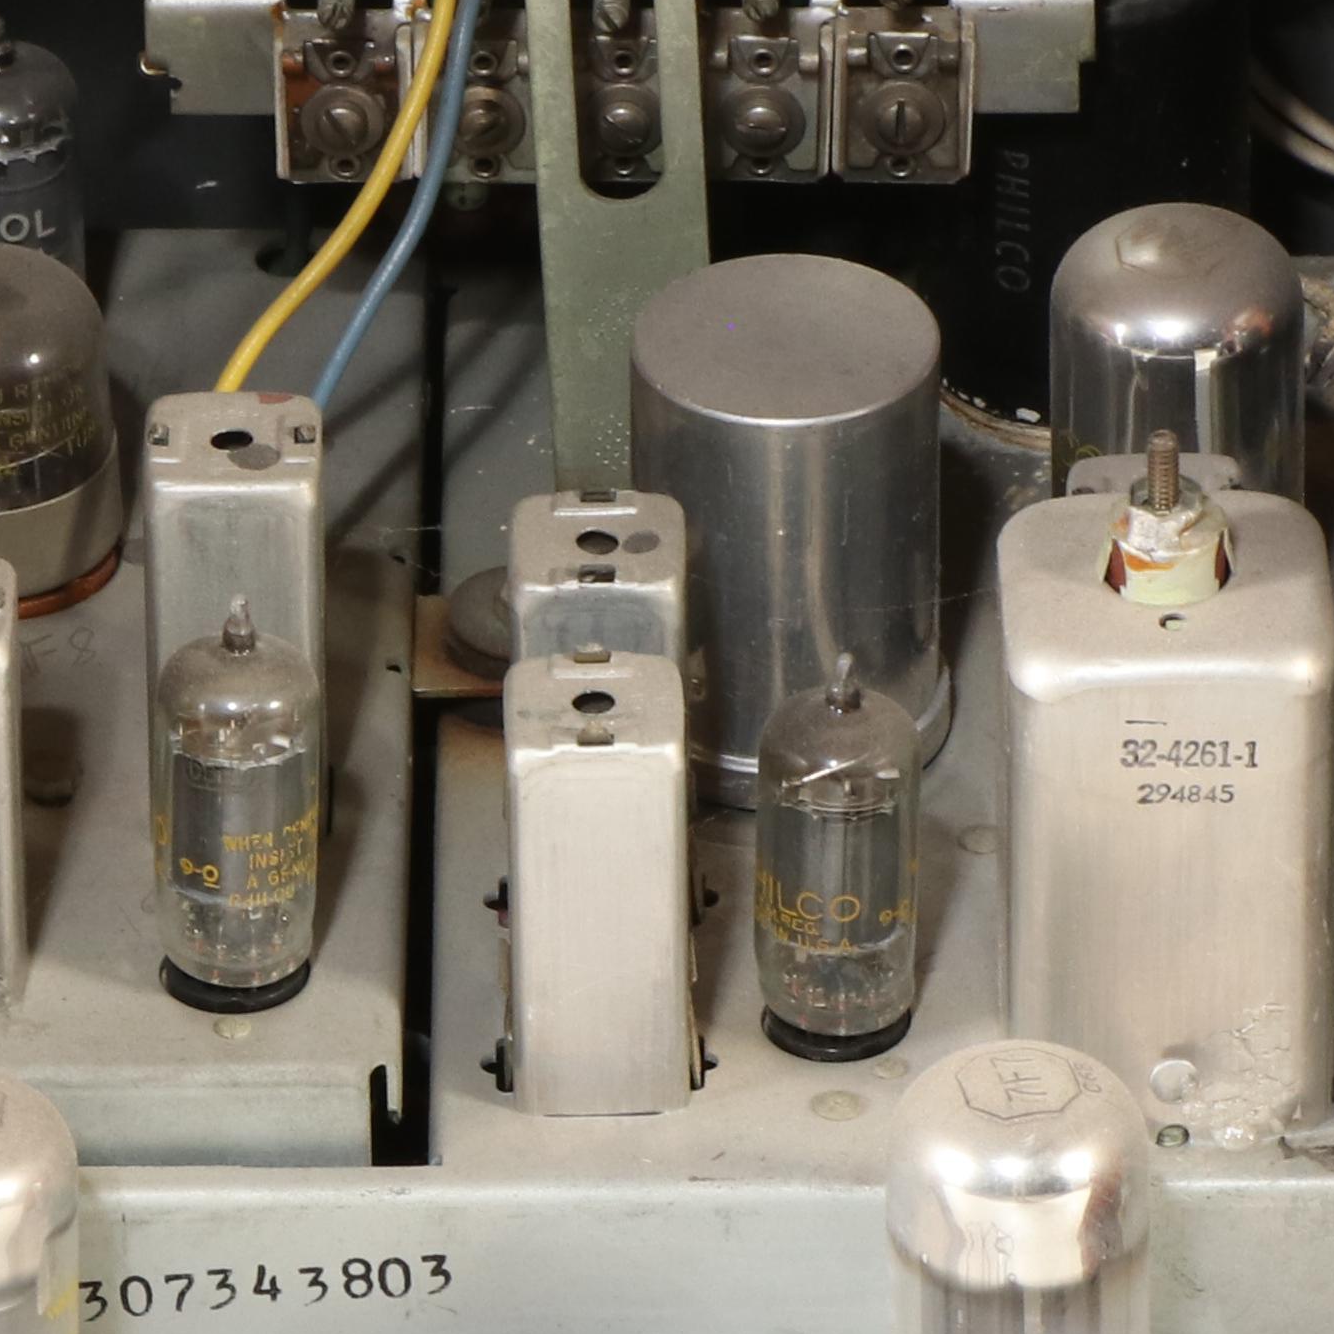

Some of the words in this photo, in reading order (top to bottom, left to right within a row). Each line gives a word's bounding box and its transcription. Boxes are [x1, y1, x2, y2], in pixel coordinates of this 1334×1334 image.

[994, 149, 1031, 293] PHILCO
[1120, 739, 1259, 769] 32-4261-1
[1136, 784, 1235, 805] 294845
[79, 1254, 453, 1322] 307343803
